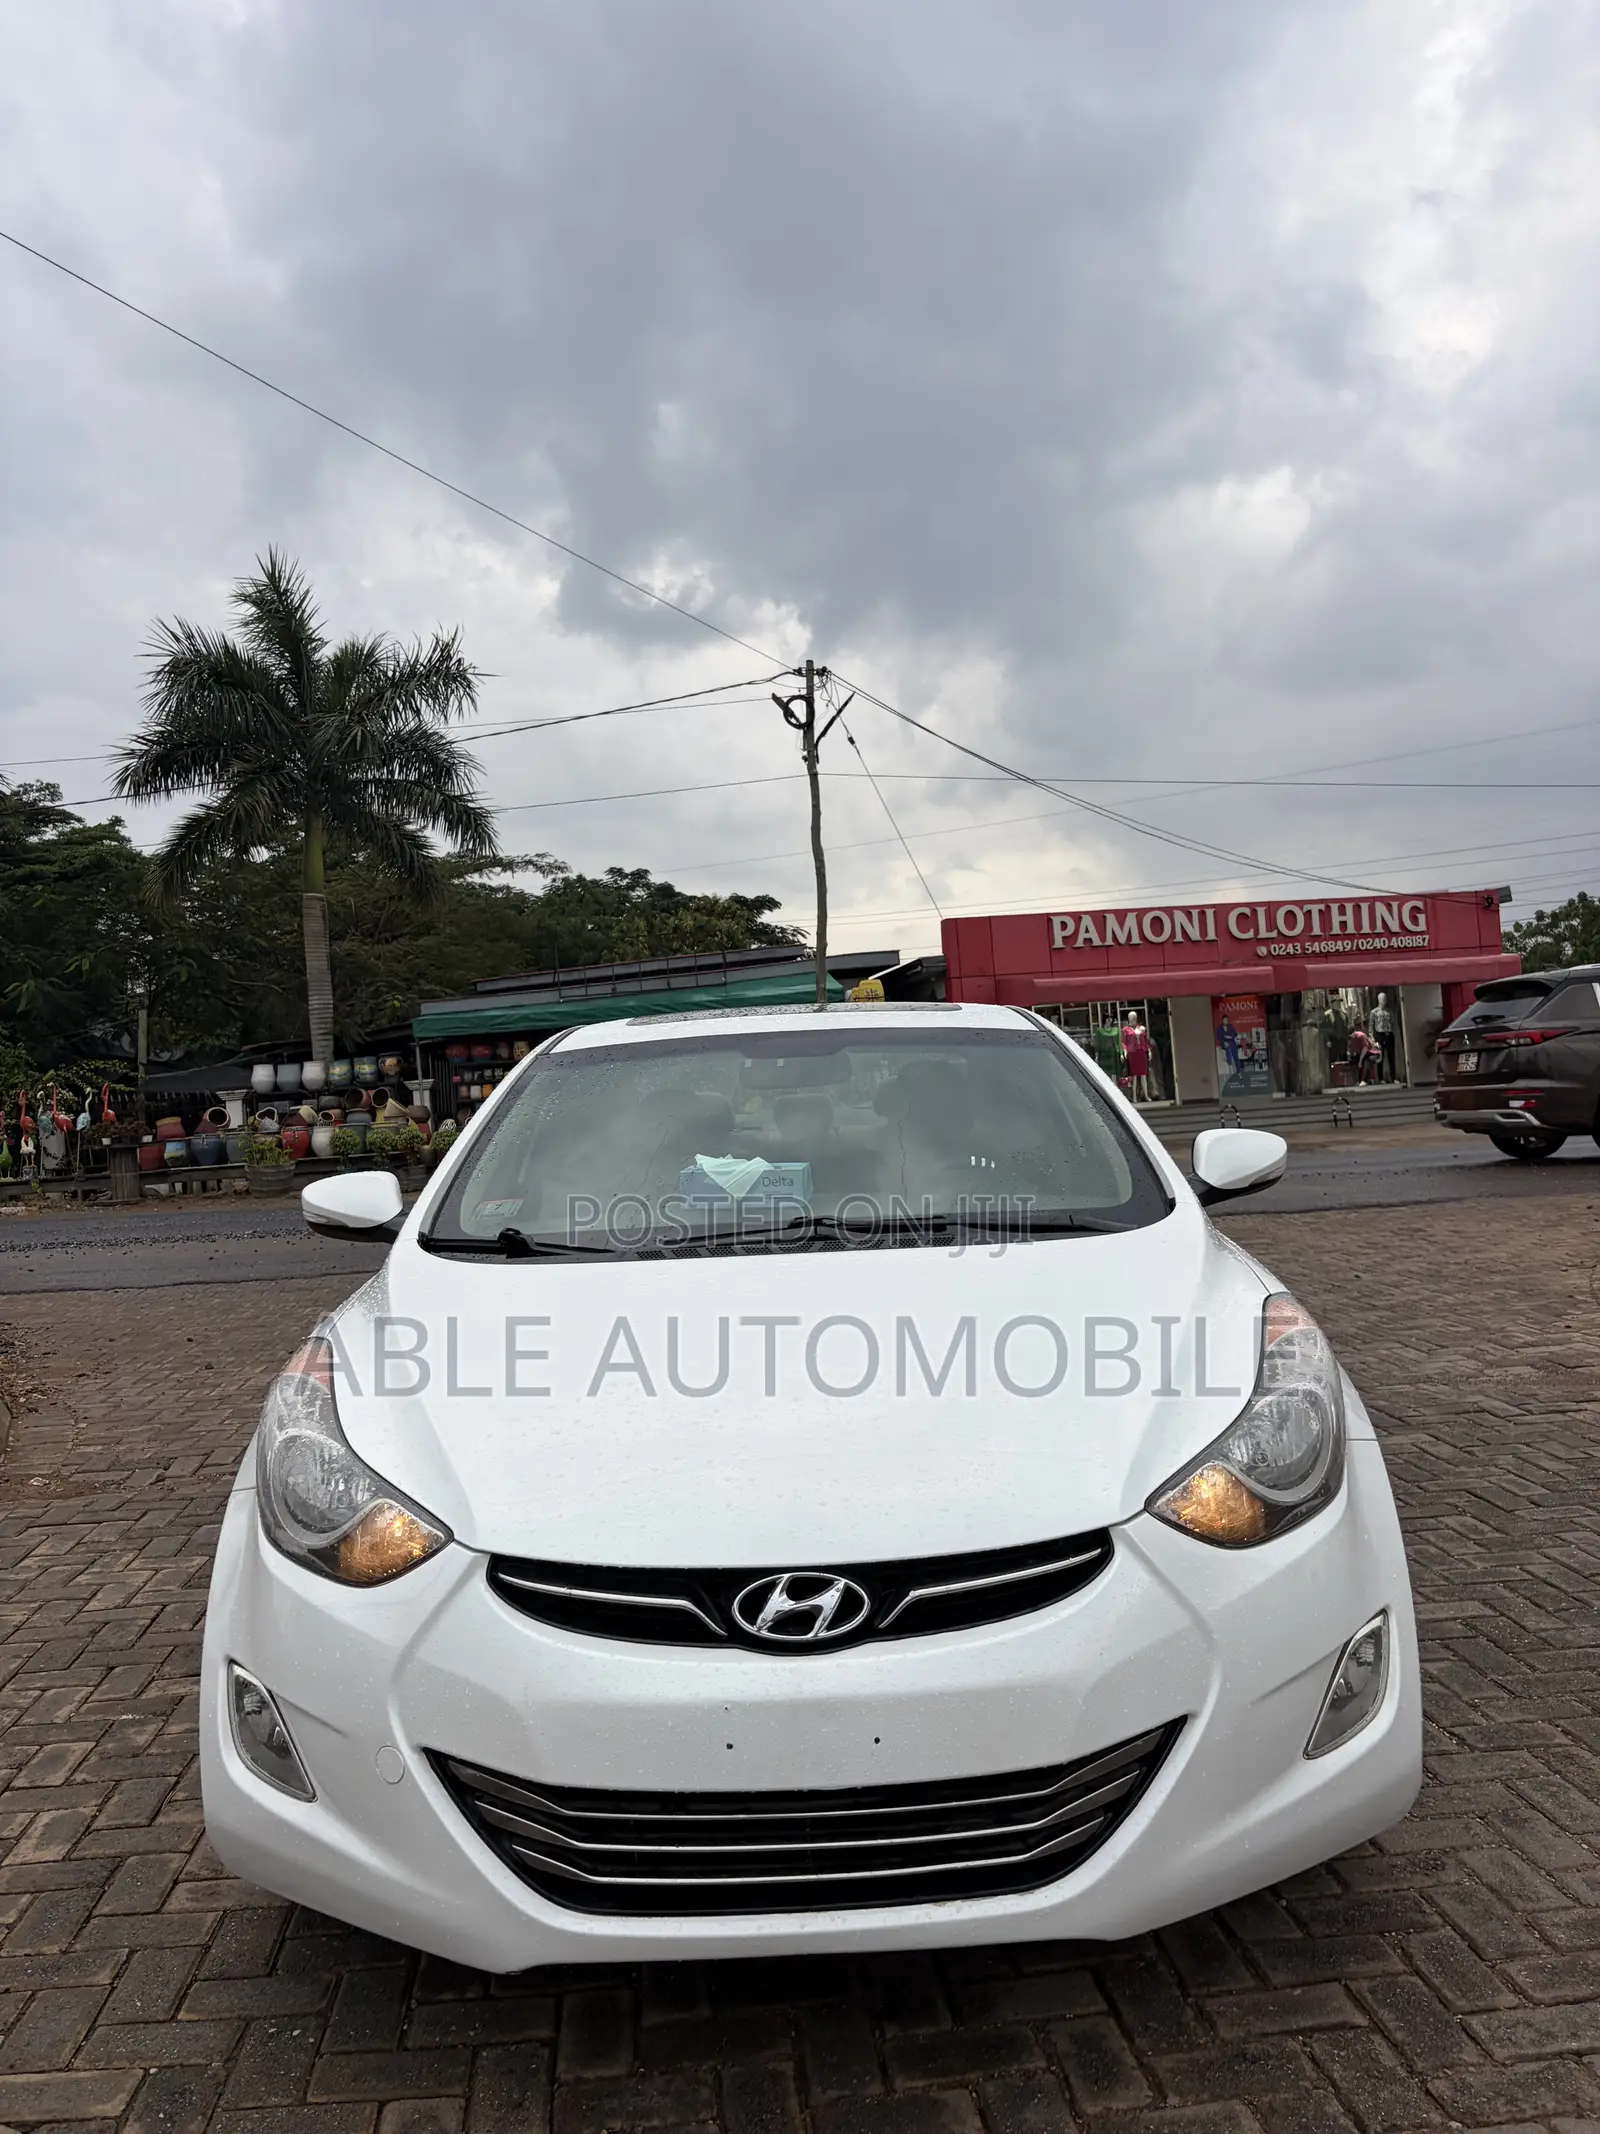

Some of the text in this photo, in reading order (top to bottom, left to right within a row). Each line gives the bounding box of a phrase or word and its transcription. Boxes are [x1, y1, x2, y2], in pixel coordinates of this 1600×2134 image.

[1050, 900, 1427, 949] PAMONI CLOTHING
[1271, 943, 1301, 956] 0243
[1390, 934, 1429, 949] 408187
[1219, 1001, 1258, 1012] PAMONI
[762, 1176, 794, 1187] Delta
